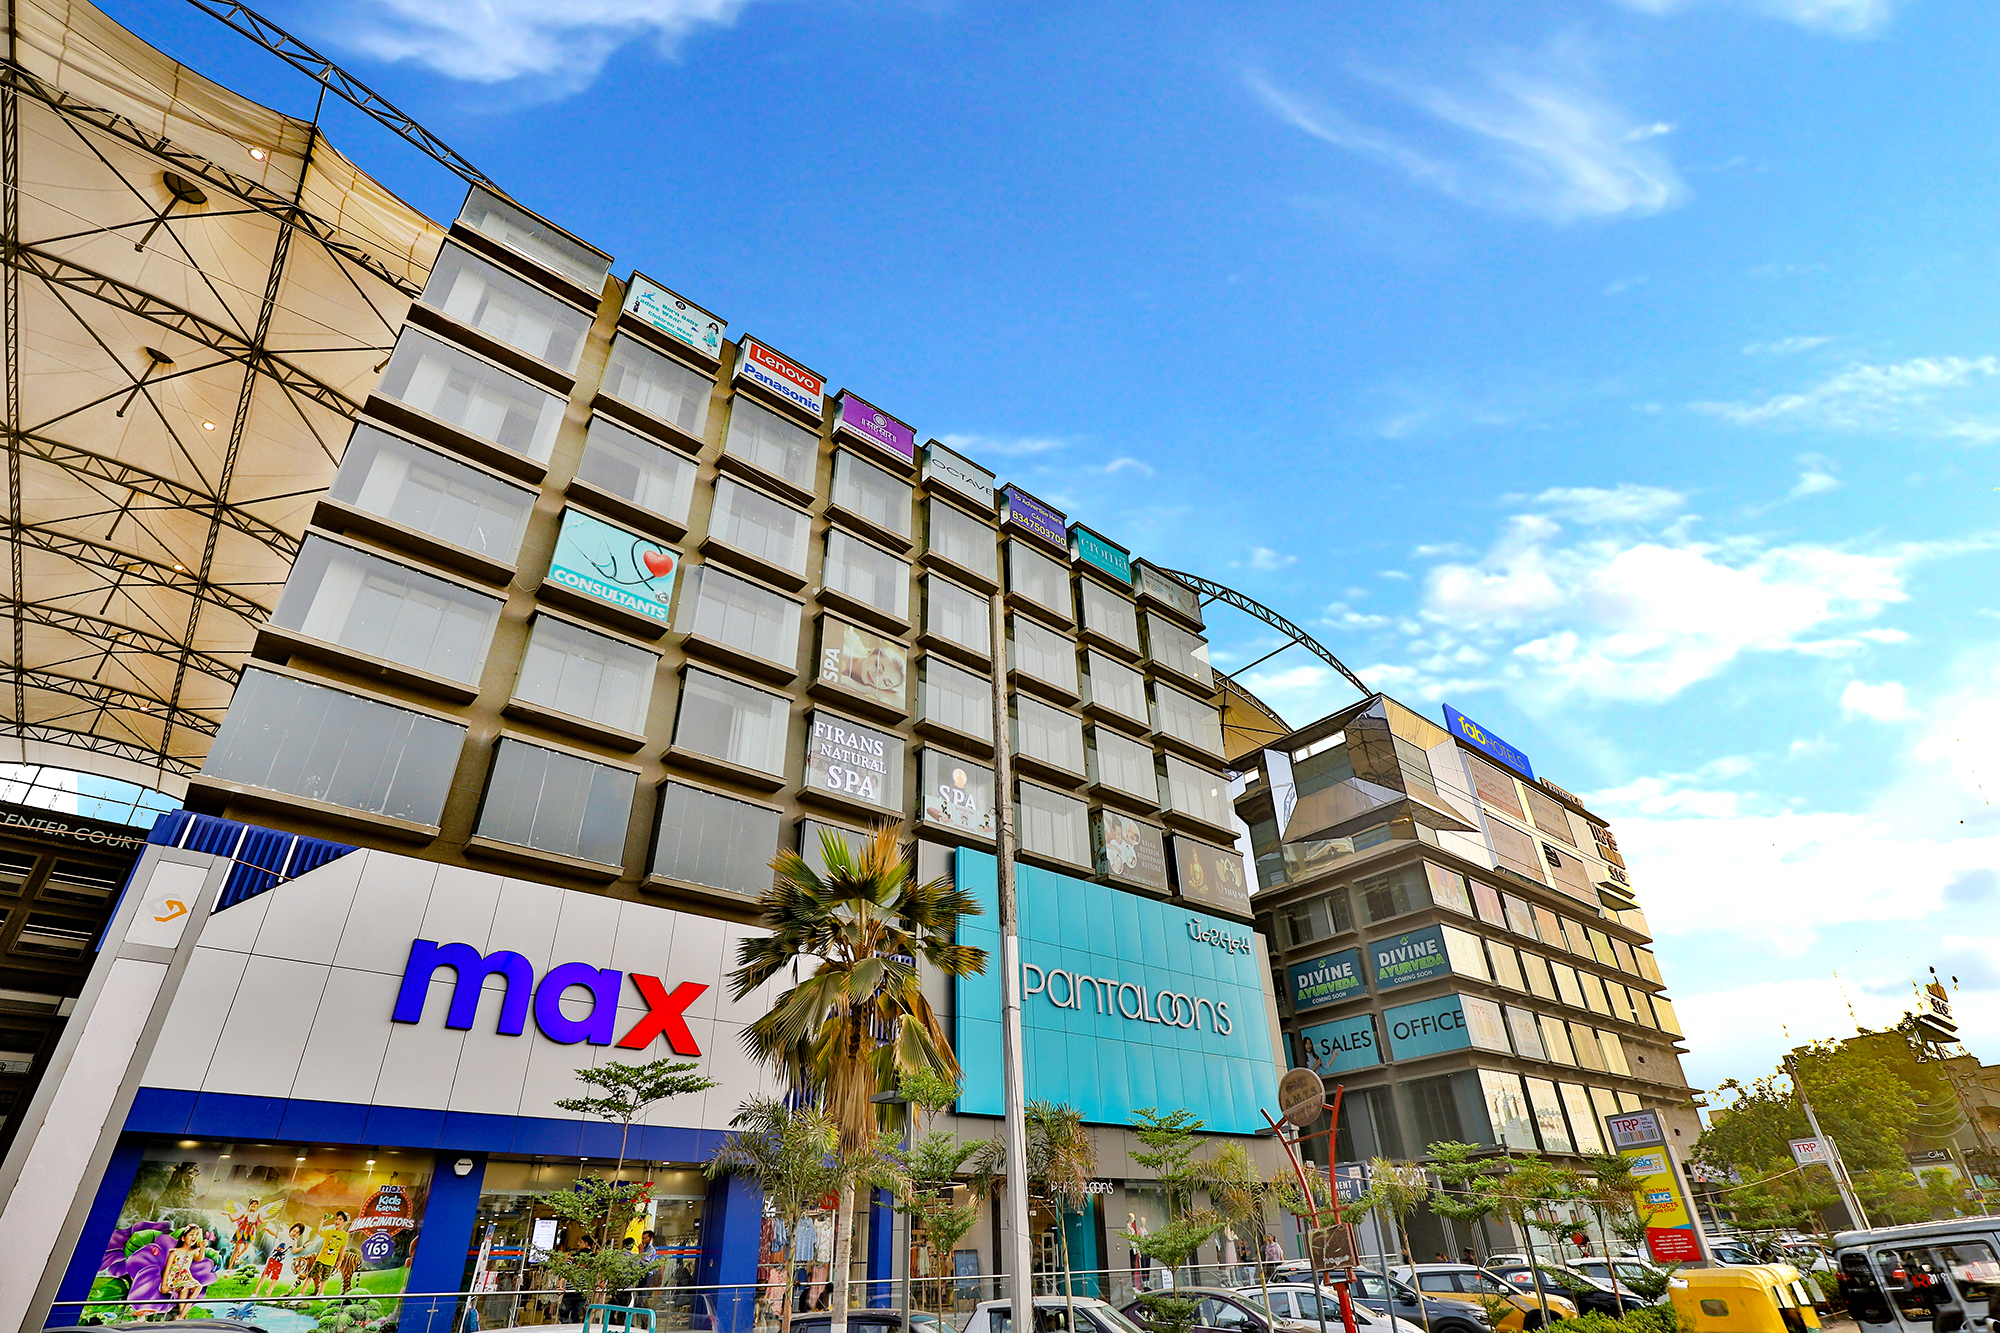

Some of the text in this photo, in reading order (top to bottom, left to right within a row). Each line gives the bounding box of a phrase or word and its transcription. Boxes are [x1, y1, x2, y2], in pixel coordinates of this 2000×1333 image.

[648, 310, 675, 328] Children
[676, 326, 694, 338] Wear
[662, 310, 682, 324] Wear
[756, 349, 814, 388] Lenovo
[744, 362, 820, 412] Panasonic
[931, 458, 993, 496] OCTAVE
[1014, 494, 1063, 525] To Advertise Here
[1031, 512, 1046, 524] CALL
[1012, 510, 1067, 546] 8347503700
[554, 569, 666, 619] CONSULTANTS
[823, 648, 840, 684] SPA
[813, 720, 884, 757] FIRANS
[820, 743, 887, 774] NATURAL
[827, 765, 876, 800] SPA
[938, 784, 977, 811] SPA
[74, 827, 145, 850] COURT
[1378, 939, 1438, 967] DIVINE
[1297, 962, 1353, 989] DIVINE
[1379, 954, 1445, 980] AYURVEDA
[1394, 969, 1433, 984] COMING SOON
[391, 938, 710, 1057] max
[1297, 976, 1359, 1001] AYURVEDA
[1312, 991, 1347, 1005] COMING SOON
[1393, 1010, 1466, 1040] OFFICE
[1320, 1029, 1372, 1056] SALES
[1612, 1118, 1639, 1133] TRP
[1794, 1142, 1817, 1154] TRP
[1927, 1150, 1947, 1161] City
[378, 1195, 402, 1206] Kids
[380, 1184, 406, 1193] max
[1642, 1202, 1679, 1211] PRODUCTS
[350, 1216, 415, 1231] IMAGINATORS
